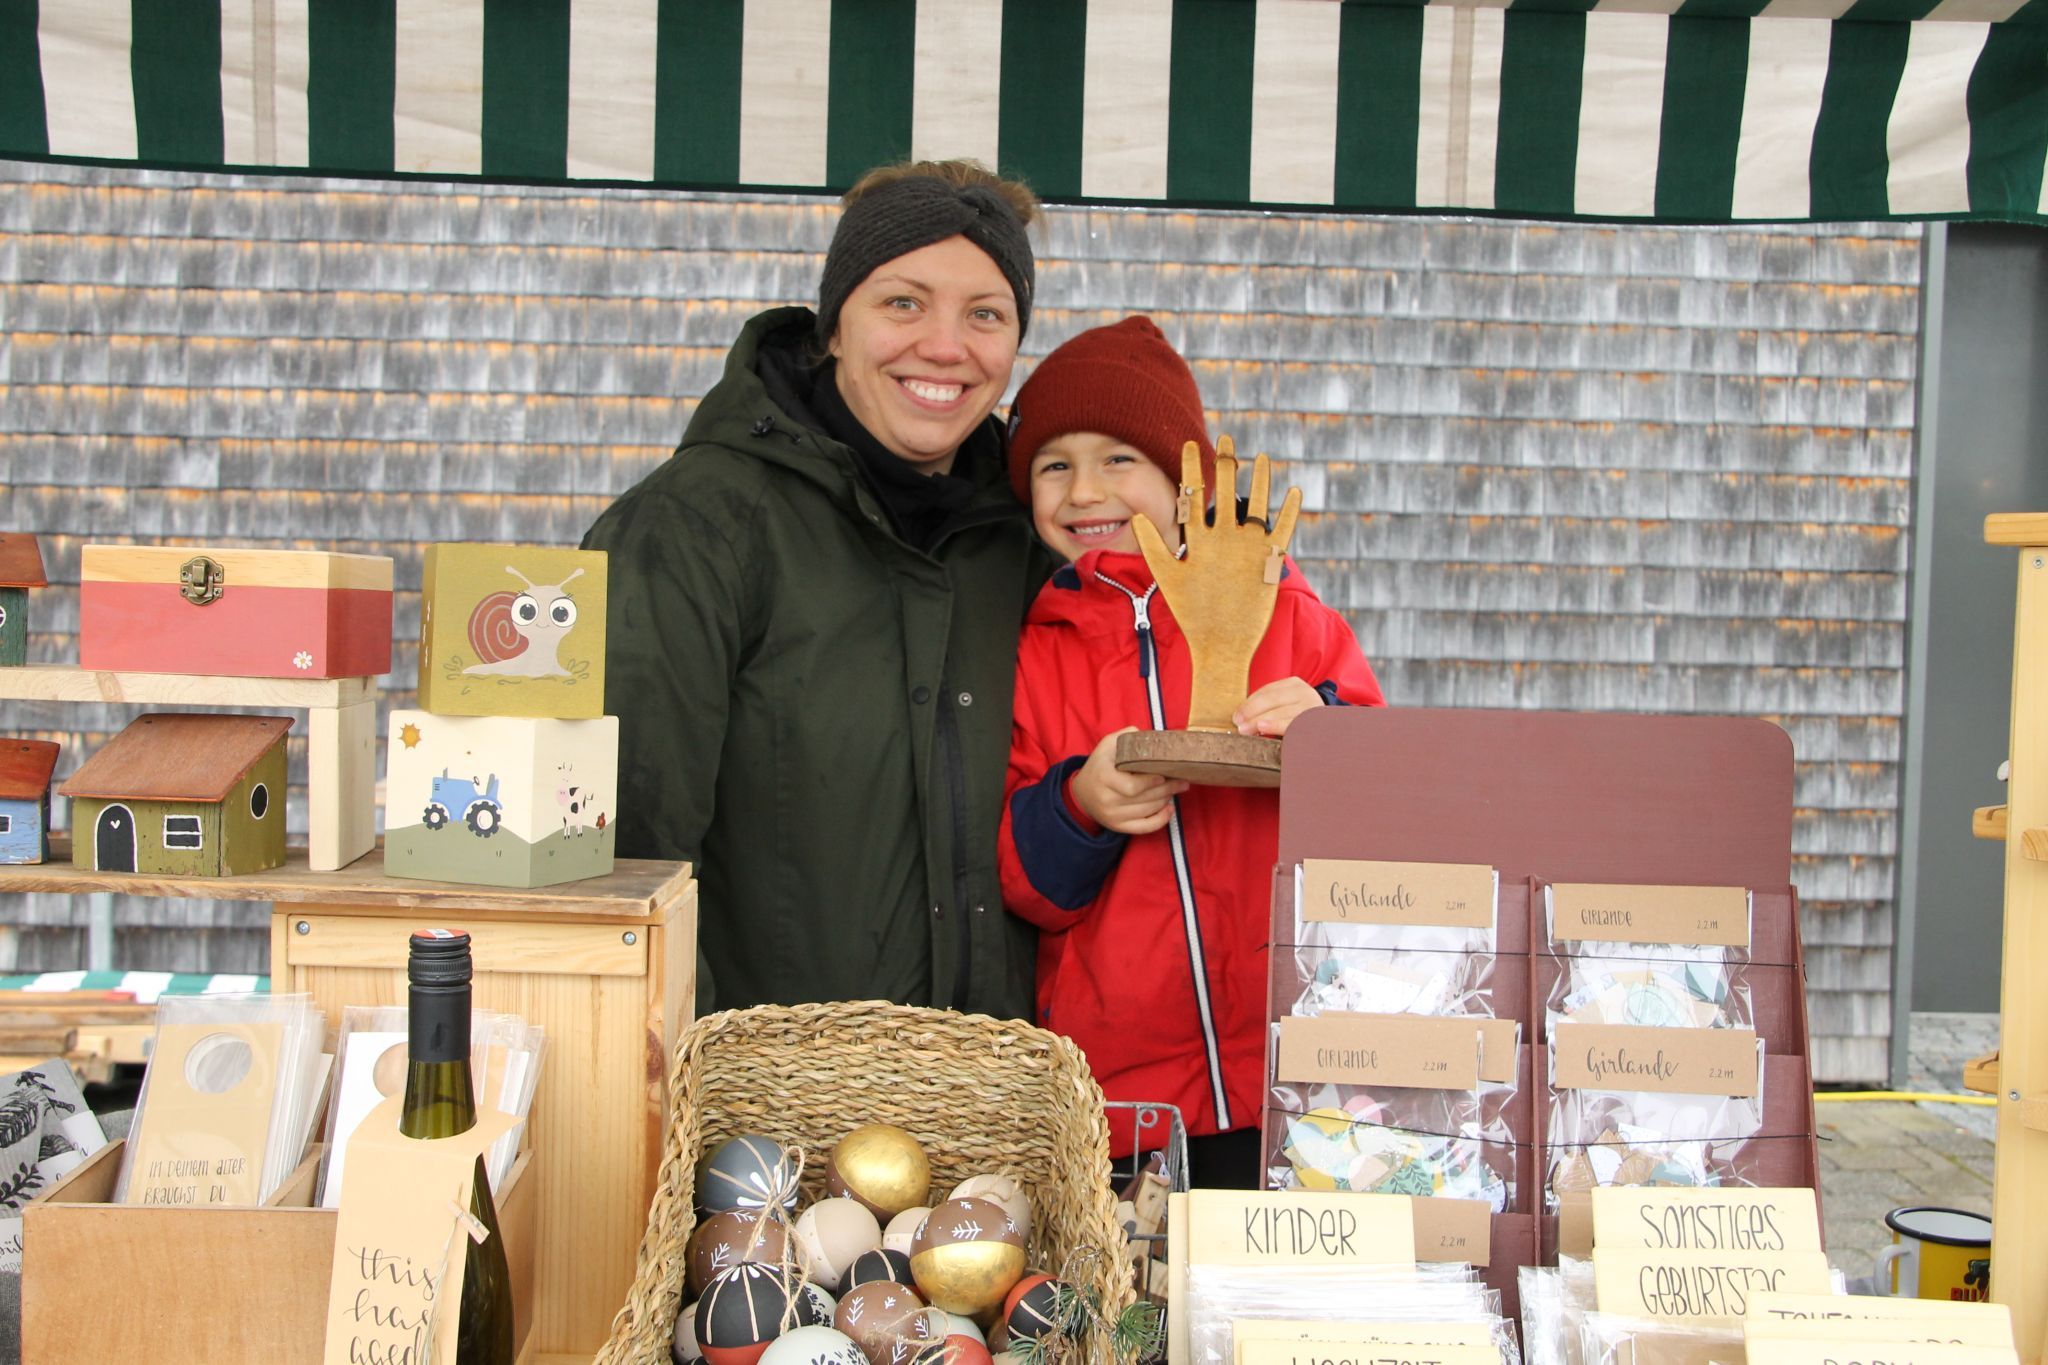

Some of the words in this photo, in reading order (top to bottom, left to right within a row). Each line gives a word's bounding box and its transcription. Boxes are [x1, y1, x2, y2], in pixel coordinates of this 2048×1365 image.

[1330, 881, 1416, 917] Girlande
[1587, 1046, 1679, 1081] Girlande
[209, 1185, 227, 1202] DU
[347, 1247, 437, 1301] this
